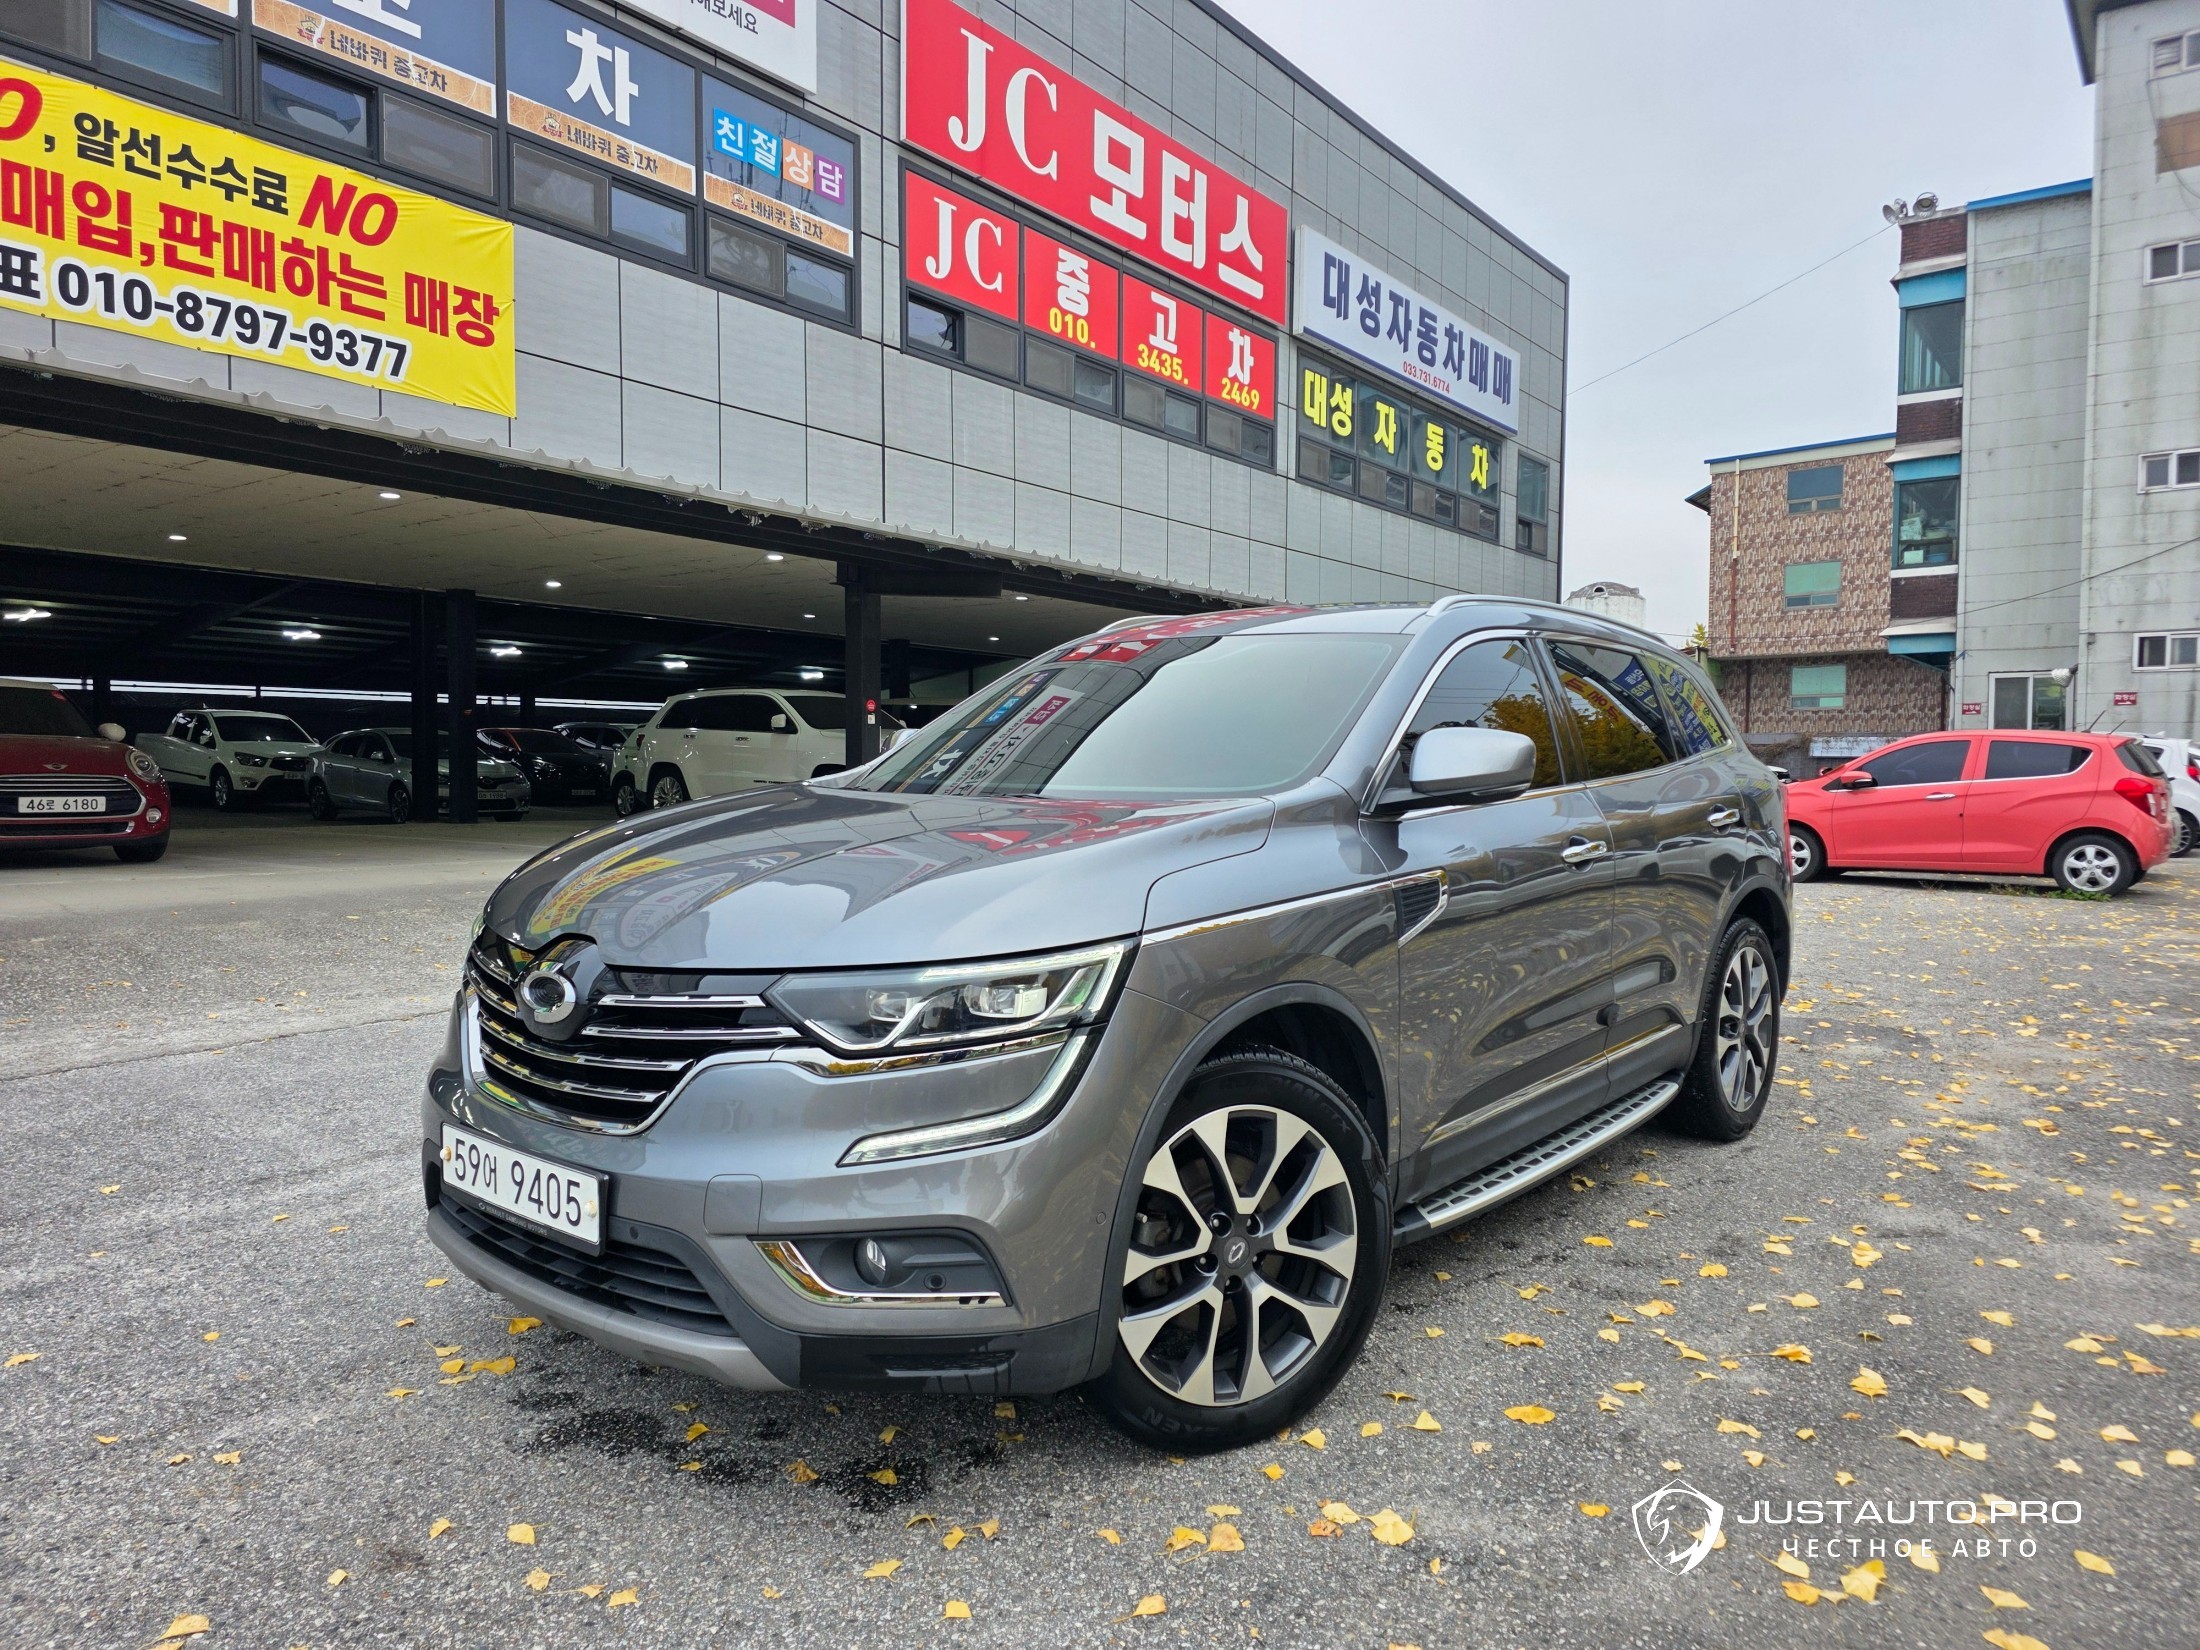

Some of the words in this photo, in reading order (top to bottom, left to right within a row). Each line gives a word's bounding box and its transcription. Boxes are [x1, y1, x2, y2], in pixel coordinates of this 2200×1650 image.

[394, 55, 448, 92] 중고차
[566, 28, 639, 127] 차
[73, 112, 289, 216] 알선수수료
[298, 174, 399, 247] NO
[616, 143, 659, 175] 중고차
[947, 27, 1058, 182] JC
[1090, 108, 1264, 300] 모터스
[0, 158, 388, 321] 매입,판매하는
[404, 271, 500, 348] 매장
[925, 197, 1003, 294] JC
[58, 263, 408, 378] 010-8797-9377
[1323, 251, 1512, 407] 대성자동차매매
[1221, 377, 1260, 411] 2469
[1304, 368, 1353, 437] 대성
[1402, 361, 1451, 395] 033.731.6774
[26, 798, 55, 811] 46로
[62, 798, 99, 810] 6180
[453, 1138, 498, 1196] 59어
[510, 1160, 582, 1228] 9405
